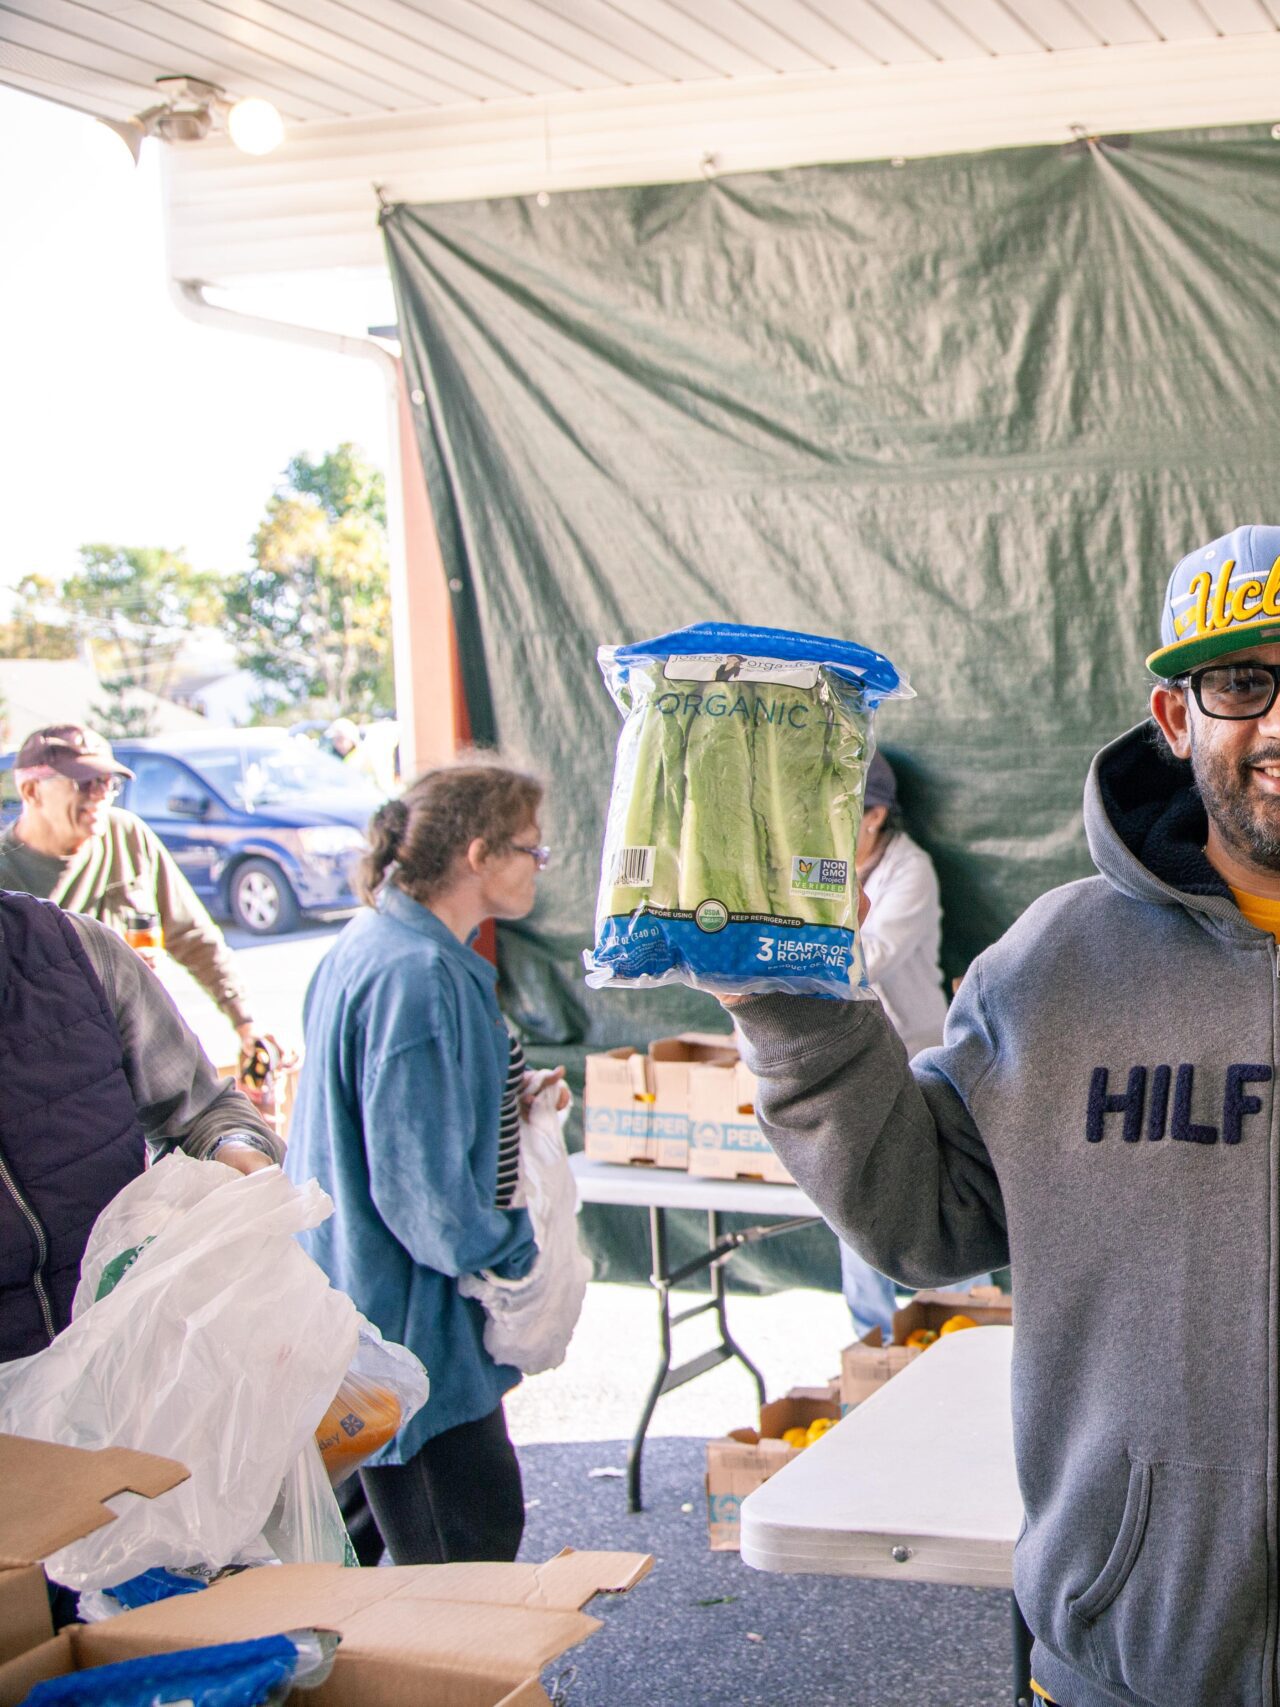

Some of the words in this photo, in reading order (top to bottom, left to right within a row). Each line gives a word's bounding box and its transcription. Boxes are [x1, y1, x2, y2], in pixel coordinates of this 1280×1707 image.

[655, 692, 810, 730] ORGANIC
[823, 861, 846, 870] NON
[822, 869, 846, 878] GMO
[821, 876, 845, 884] Project
[795, 881, 844, 892] VERIFIED
[673, 911, 693, 919] USING
[750, 914, 801, 926] REFRIGERATED
[630, 929, 649, 942] (340
[650, 926, 660, 936] g)
[756, 936, 775, 962] 3
[777, 940, 828, 954] HEARTS
[830, 945, 849, 956] OF
[777, 950, 846, 968] ROMAINE
